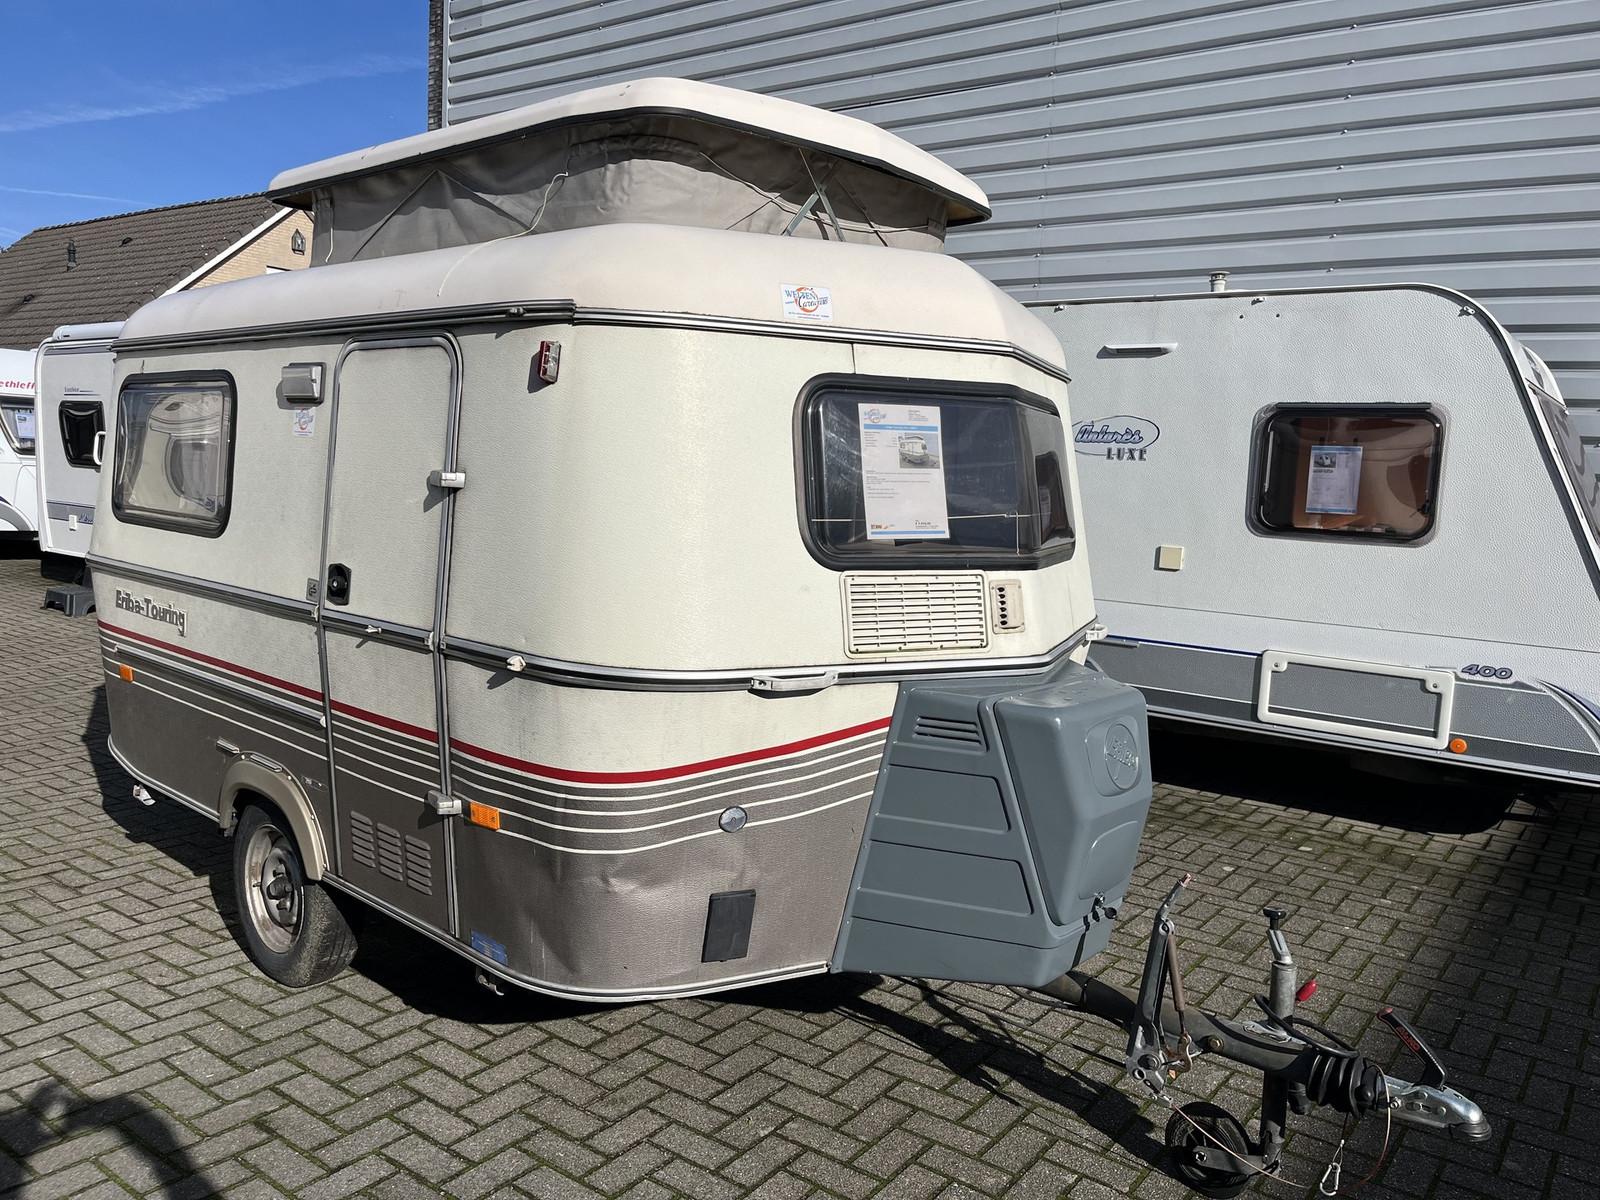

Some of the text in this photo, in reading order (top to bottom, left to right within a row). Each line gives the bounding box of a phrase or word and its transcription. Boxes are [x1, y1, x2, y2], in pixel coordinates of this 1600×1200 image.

[1106, 447, 1147, 461] LUXE
[116, 590, 187, 638] Eriba-Touring
[1461, 663, 1513, 679] 400
